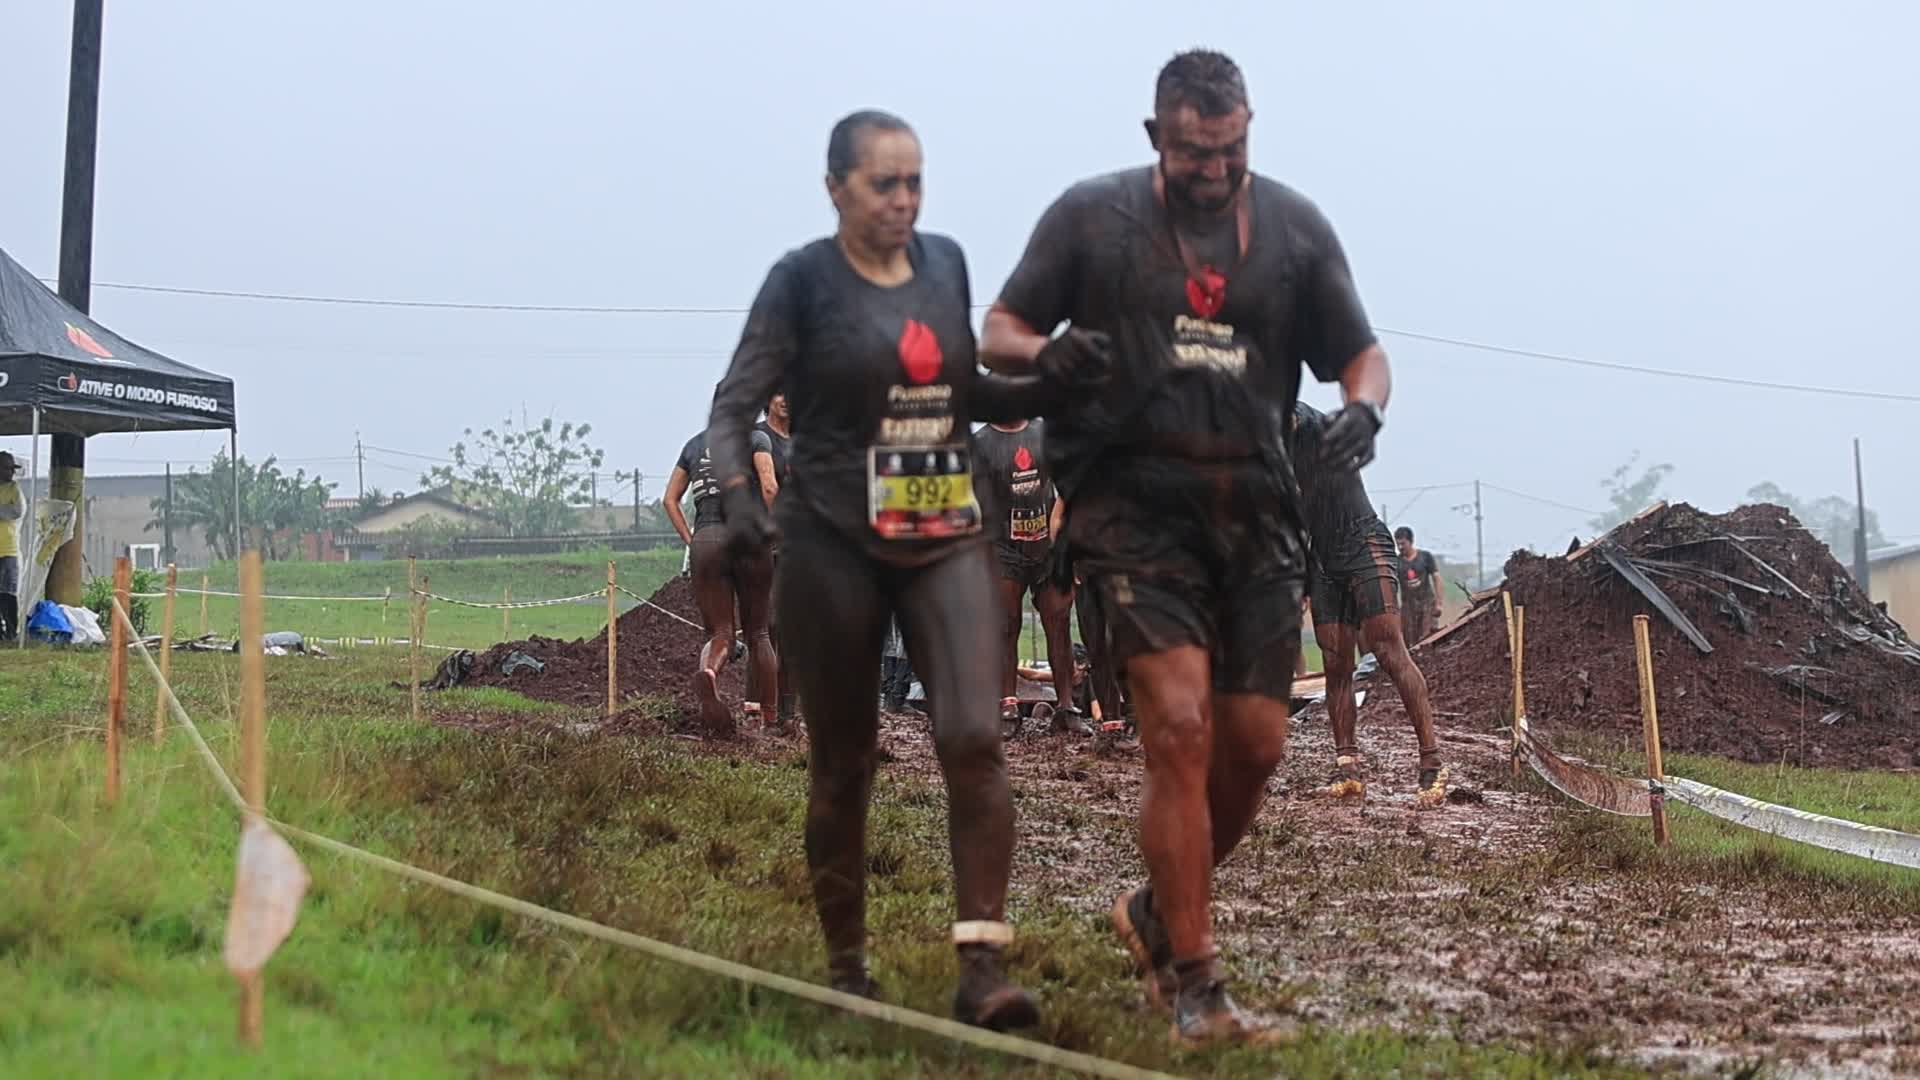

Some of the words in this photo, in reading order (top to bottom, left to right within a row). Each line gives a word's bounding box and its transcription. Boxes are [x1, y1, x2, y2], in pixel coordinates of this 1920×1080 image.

[78, 379, 113, 397] ATIVE
[114, 383, 125, 398] O
[126, 385, 164, 404] MODO
[165, 391, 218, 412] FURIOSO
[906, 477, 953, 506] 992
